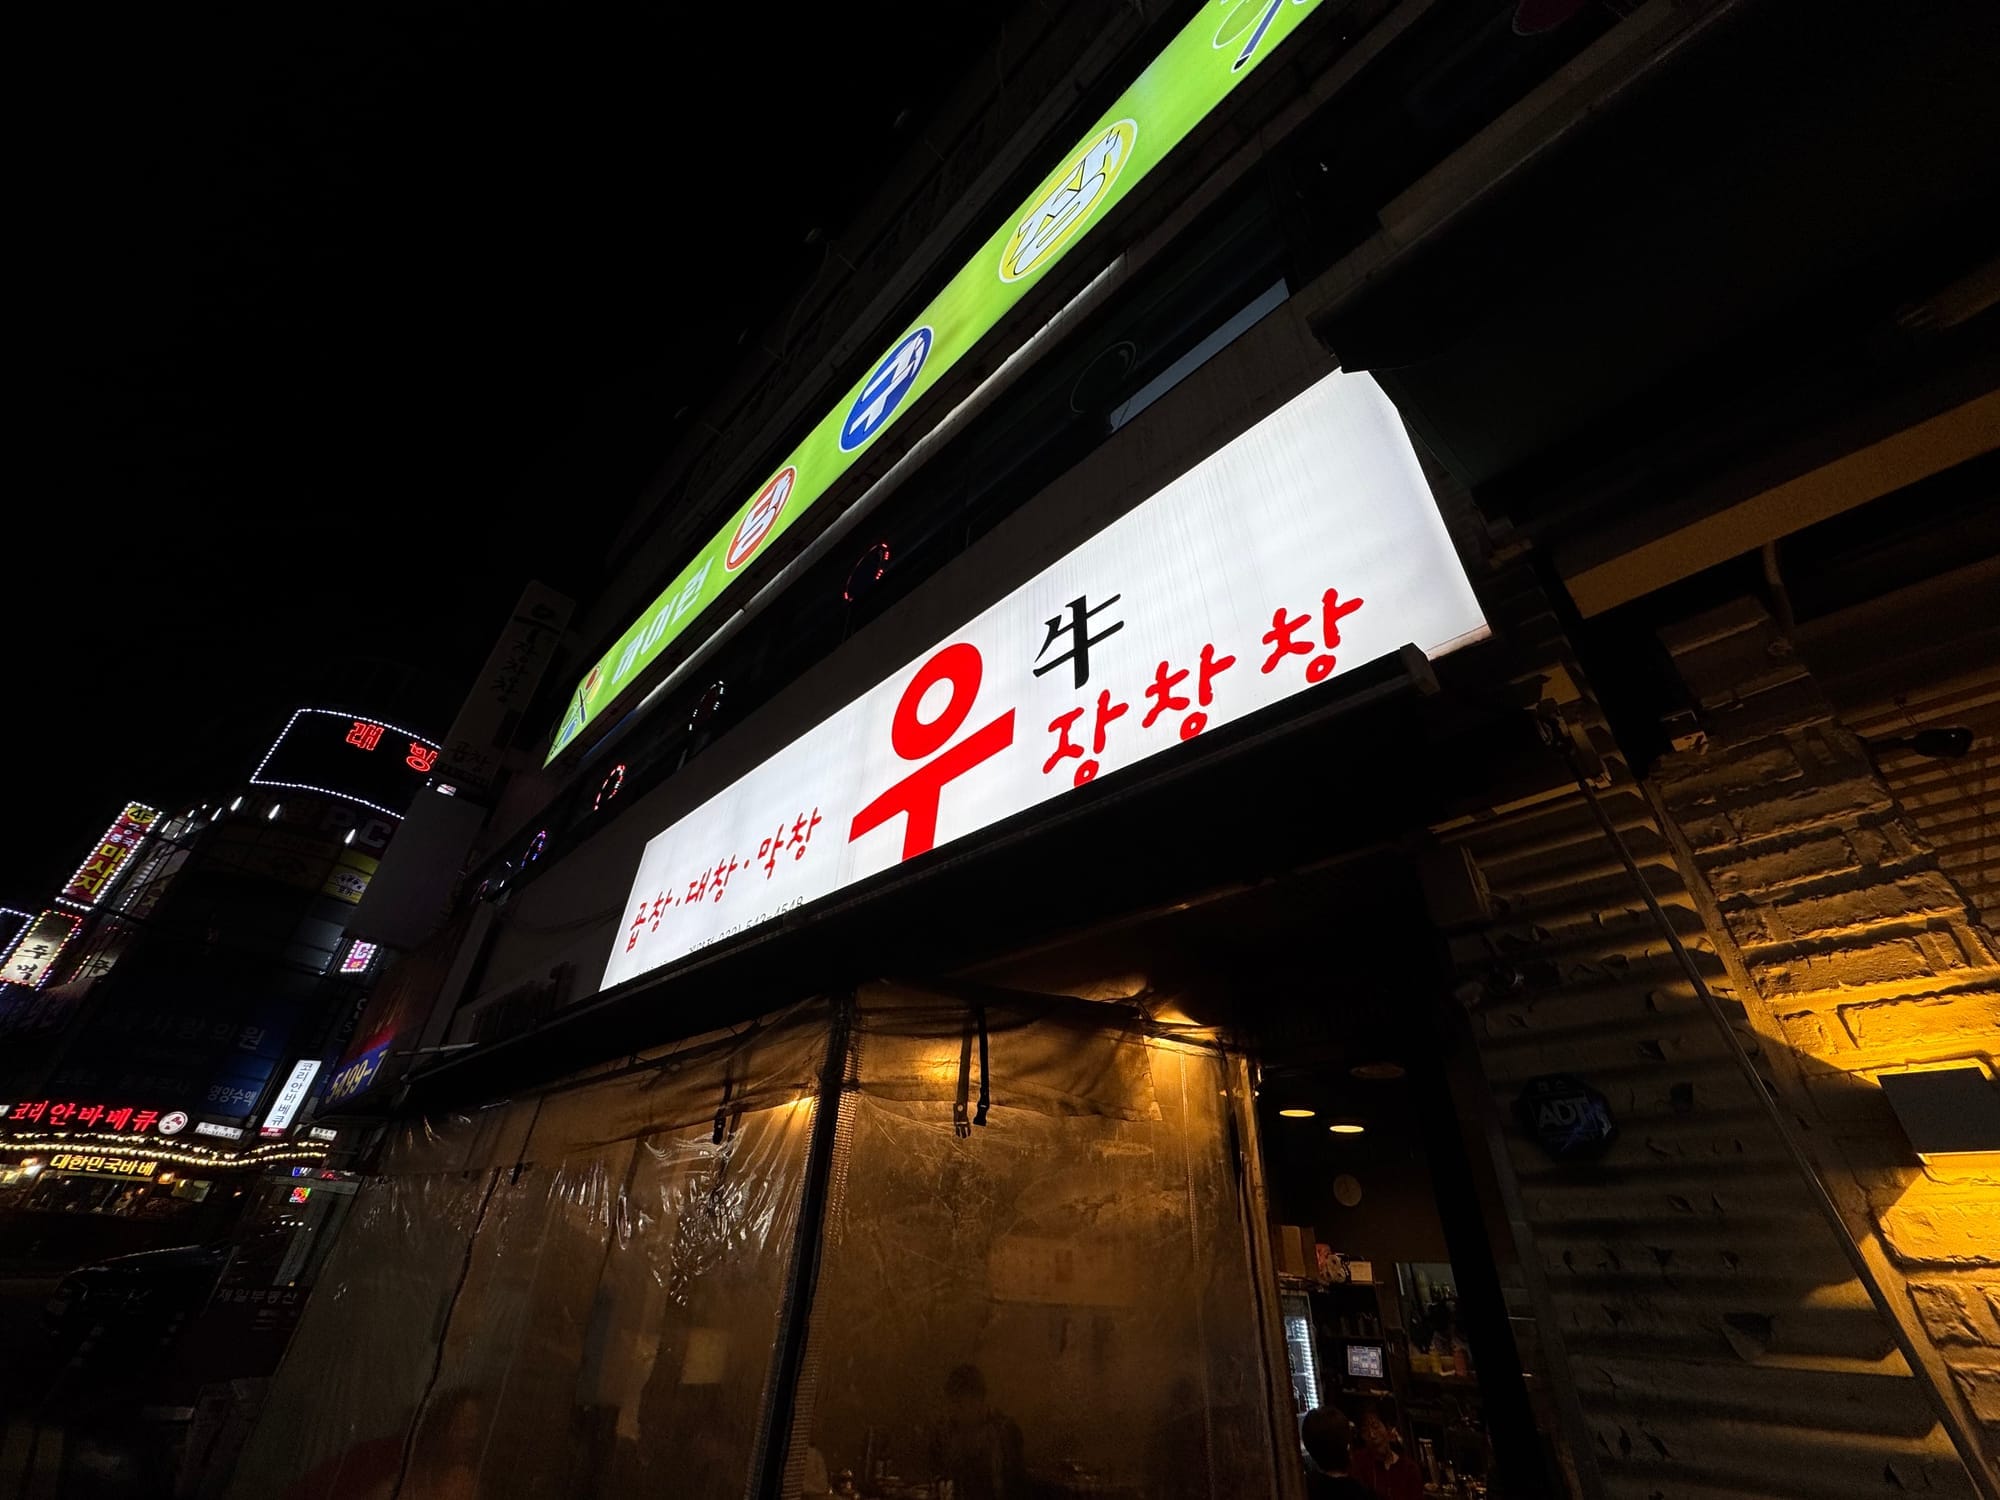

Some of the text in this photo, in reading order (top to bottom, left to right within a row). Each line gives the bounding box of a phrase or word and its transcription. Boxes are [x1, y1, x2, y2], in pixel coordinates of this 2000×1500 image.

[1032, 594, 1124, 689] 牛
[130, 808, 154, 823] 4F
[73, 843, 127, 895] 마사지
[9, 1100, 159, 1133] 코리안바베큐
[272, 1062, 313, 1127] 코리안바베큐
